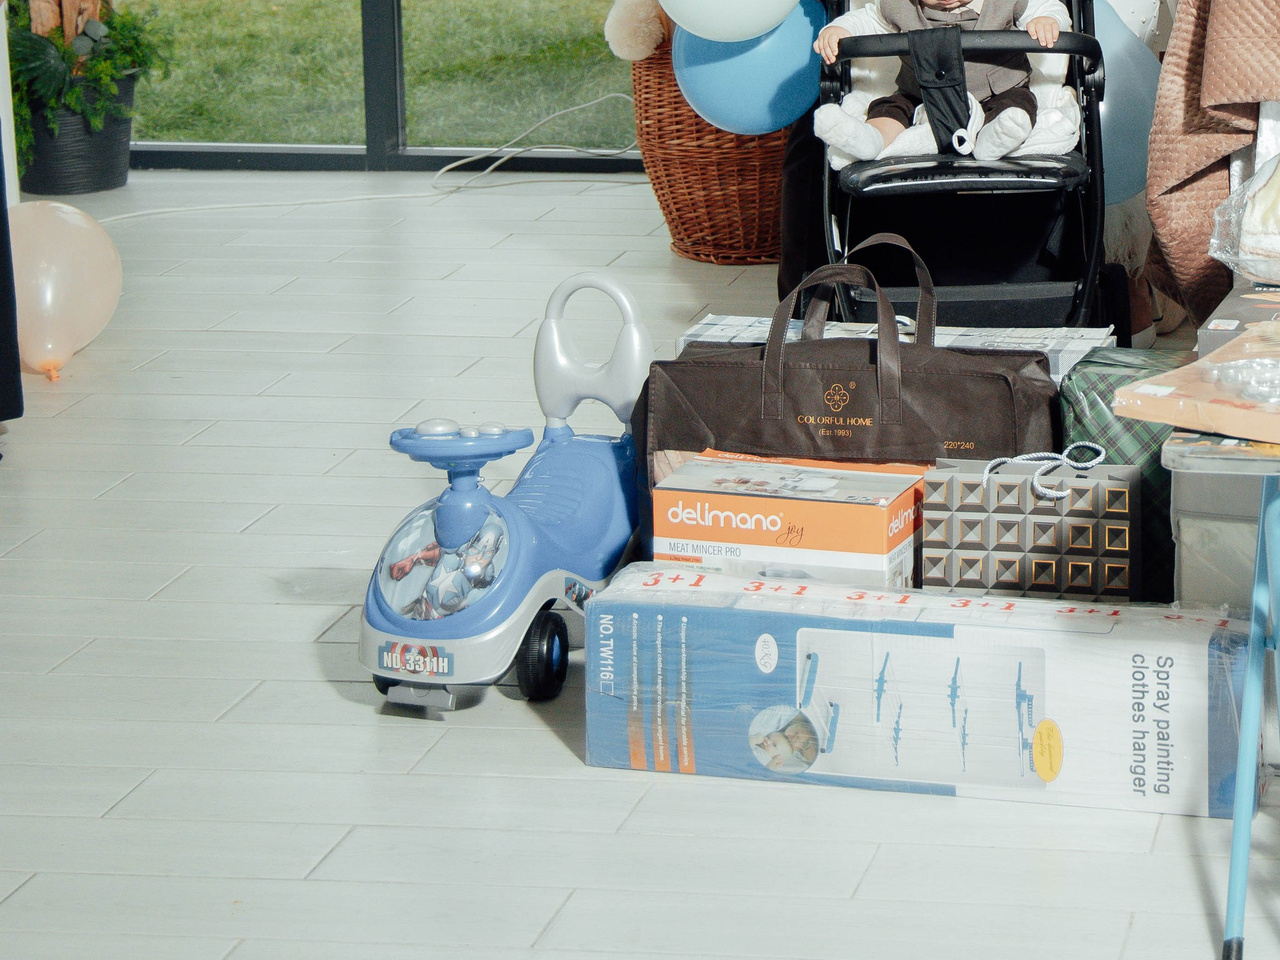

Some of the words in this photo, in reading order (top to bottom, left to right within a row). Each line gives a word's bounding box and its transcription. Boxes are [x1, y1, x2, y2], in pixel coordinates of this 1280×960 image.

[797, 414, 846, 426] COLORFUL
[846, 417, 874, 427] HOME
[667, 500, 782, 532] delimano
[775, 522, 805, 546] joy
[668, 541, 690, 554] MEAT
[691, 542, 723, 557] MINCER
[724, 545, 742, 558] PRO
[382, 650, 449, 674] NO.3311H
[759, 638, 772, 669] 40KG
[655, 675, 663, 695] hanger
[1131, 653, 1150, 724] clothes
[1152, 655, 1175, 714] Spray
[656, 725, 664, 745] elegant
[1129, 729, 1150, 797] hanger
[1152, 719, 1175, 796] painting
